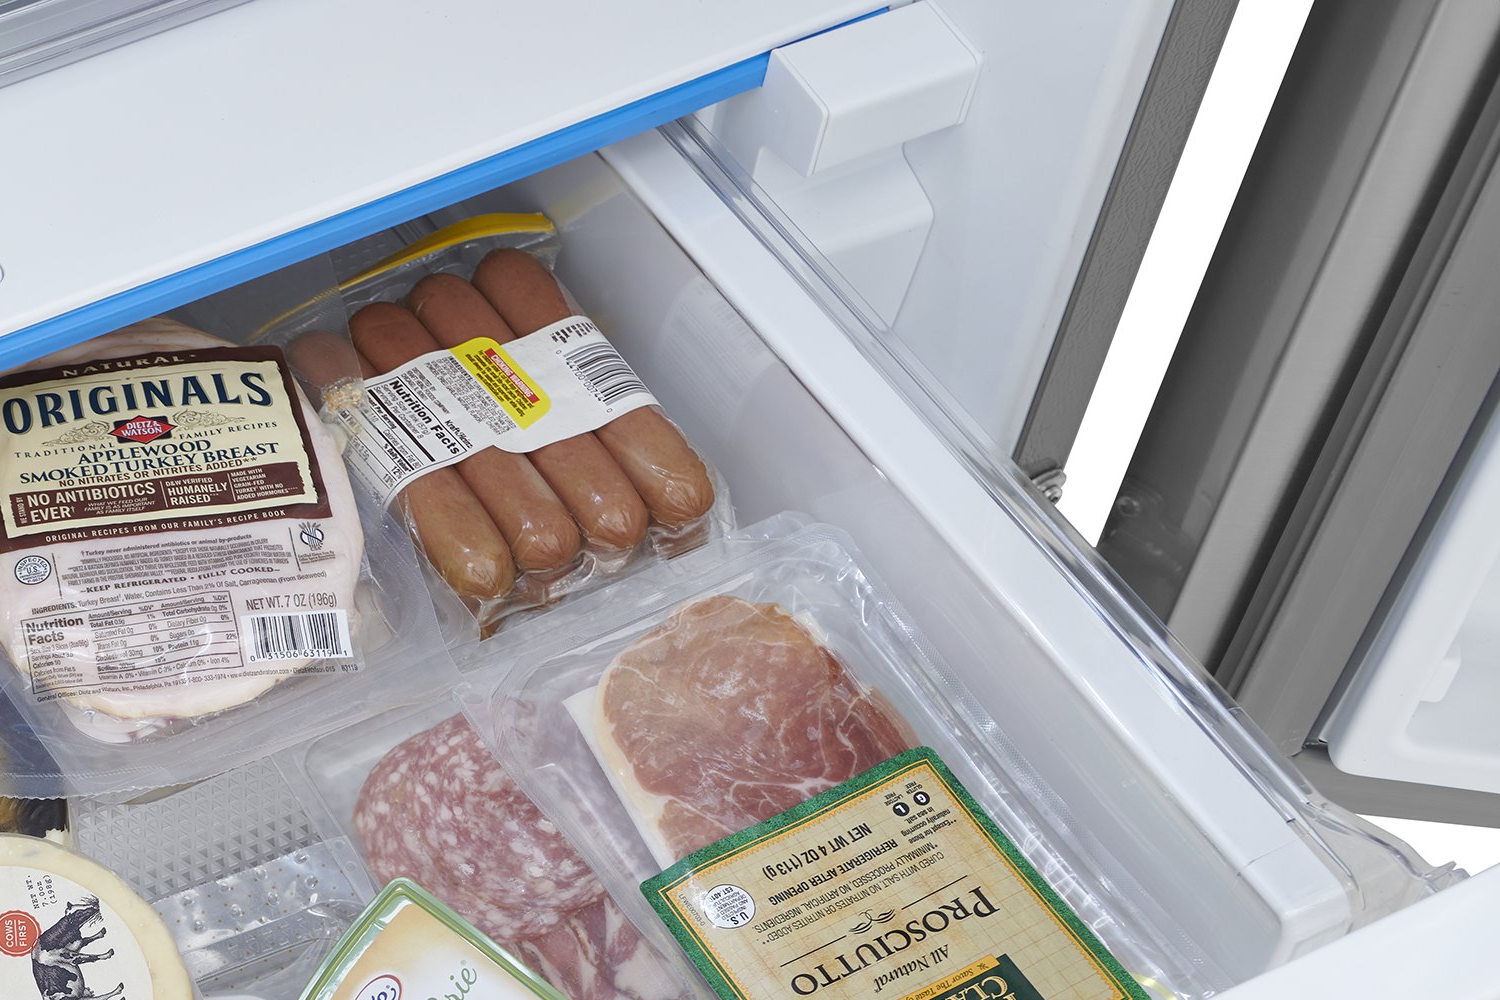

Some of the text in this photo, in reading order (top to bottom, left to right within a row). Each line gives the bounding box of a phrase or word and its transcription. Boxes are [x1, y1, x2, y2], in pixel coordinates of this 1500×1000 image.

[62, 355, 184, 377] NATURAL
[2, 372, 272, 434] ORIGINALS
[121, 425, 163, 436] WATSON
[126, 420, 151, 431] DIETZ
[389, 380, 432, 424] Nutrition
[430, 425, 459, 455] Facts
[14, 421, 278, 459] TRADITIONAL FAMILY RECIPES
[78, 440, 211, 465] APPLEWOOD
[20, 443, 280, 484] SMOKED TURKEY BREAST
[59, 477, 75, 487] NO
[79, 471, 131, 485] NITRATES
[153, 463, 204, 477] NITRITES
[28, 483, 156, 507] NO ANTIBIOTICS
[46, 532, 88, 542] ORIGINAL
[92, 527, 129, 536] RECIPES
[133, 523, 158, 532] FROM
[183, 517, 222, 527] FAMILY'S
[227, 513, 260, 523] RECIPE
[246, 598, 266, 611] NET
[268, 597, 283, 608] WT.
[294, 595, 307, 607] OZ
[308, 592, 337, 609] (196g)
[801, 823, 872, 865] NET WT 4 OZ
[768, 839, 898, 905] REFRIGERATE AFTER OPENING
[5, 920, 14, 947] COWS
[19, 920, 28, 947] FIRST
[791, 886, 1000, 996] PROSCIUTTO
[931, 944, 949, 964] All
